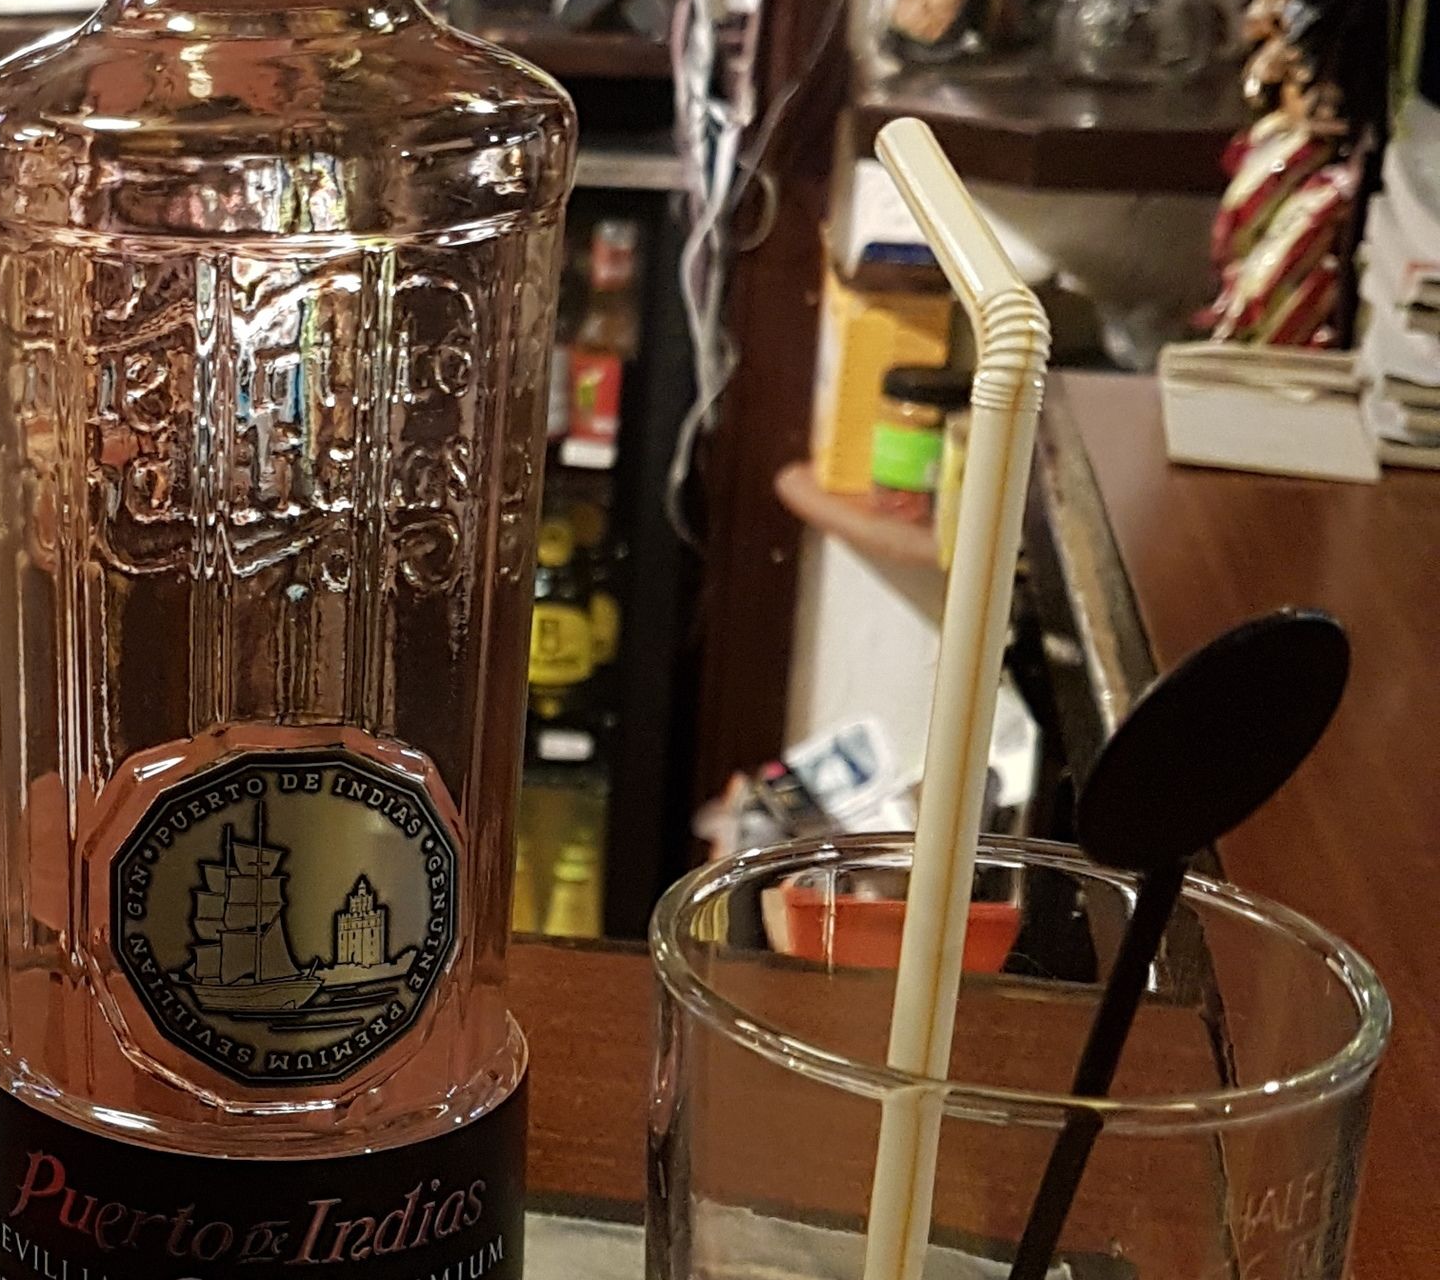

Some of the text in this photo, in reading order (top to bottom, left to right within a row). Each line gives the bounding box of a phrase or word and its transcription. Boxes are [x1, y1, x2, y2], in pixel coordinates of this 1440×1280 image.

[158, 773, 421, 846] PUERTO DE INDIAS
[125, 865, 150, 918] GIN
[417, 855, 446, 995] GENUINE
[125, 933, 253, 1064] SEVILLIAN
[268, 1002, 405, 1071] PREMIUM
[9, 1149, 234, 1261] Puerto
[283, 1178, 487, 1266] Indias
